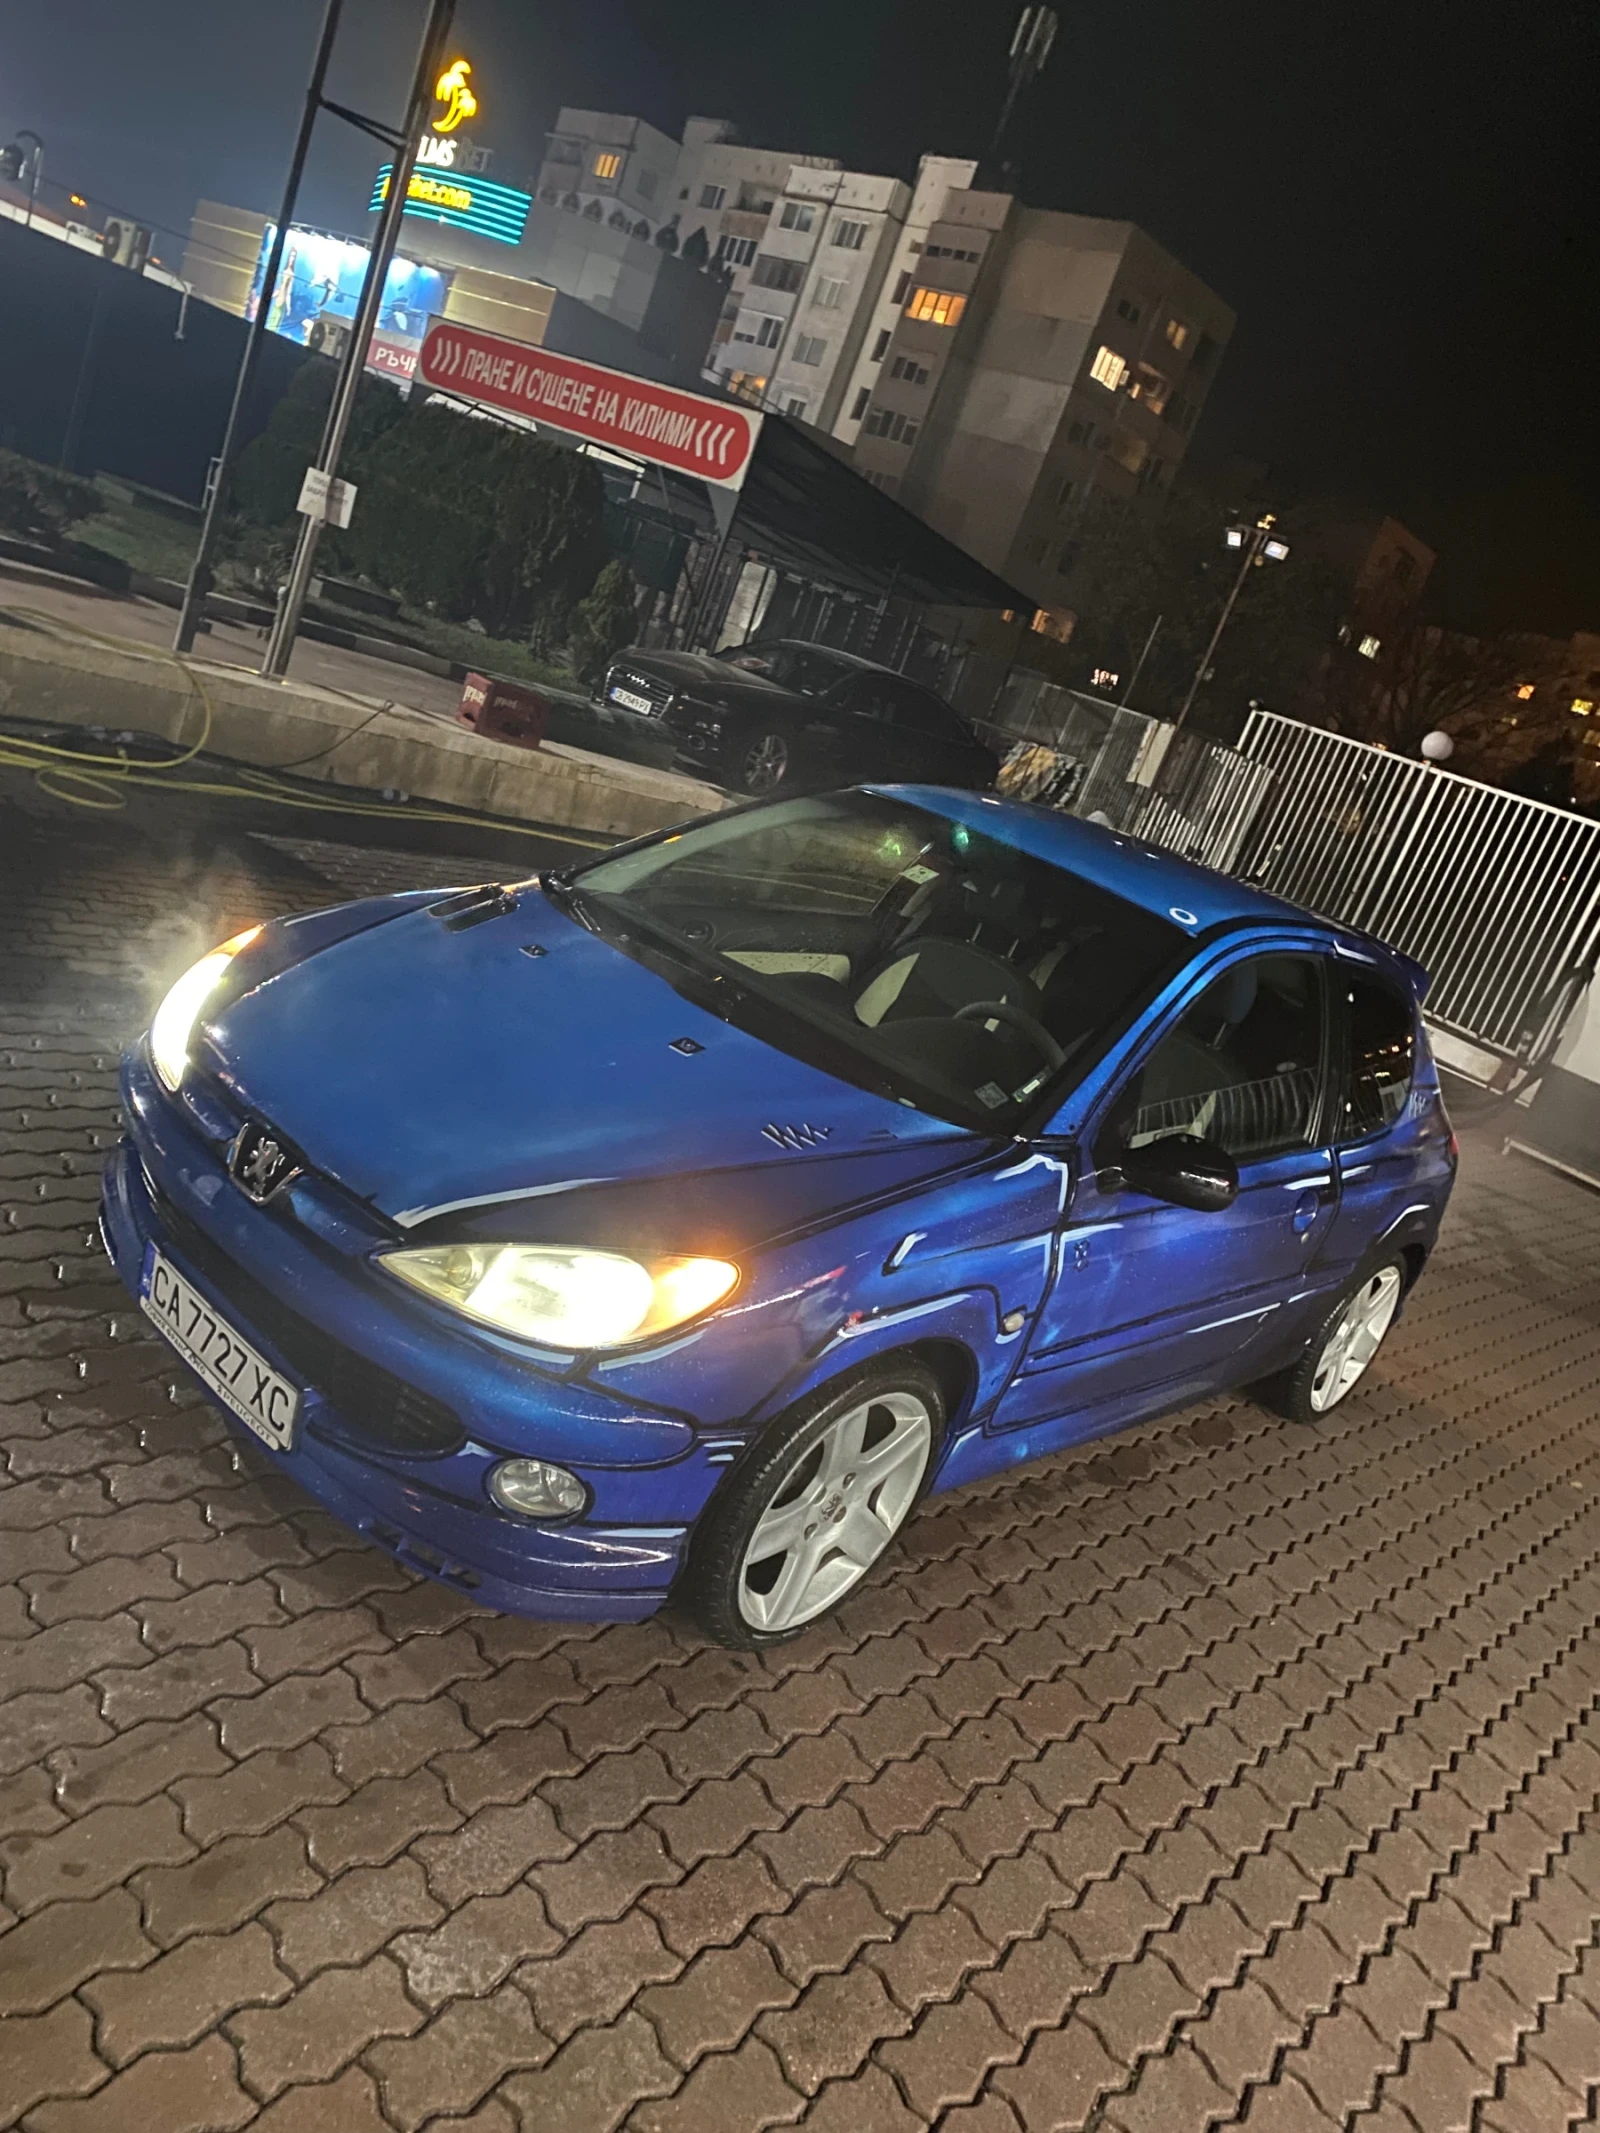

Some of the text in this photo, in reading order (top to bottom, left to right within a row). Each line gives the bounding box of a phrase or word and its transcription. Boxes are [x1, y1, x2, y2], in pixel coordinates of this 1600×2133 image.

[415, 135, 457, 167] LMS
[461, 347, 697, 451] ПРАНЕ И СУШЕНЕ НА КИЛИМИ
[153, 1265, 289, 1432] CA 7727 XC
[223, 1391, 271, 1441] PEUGEOT
